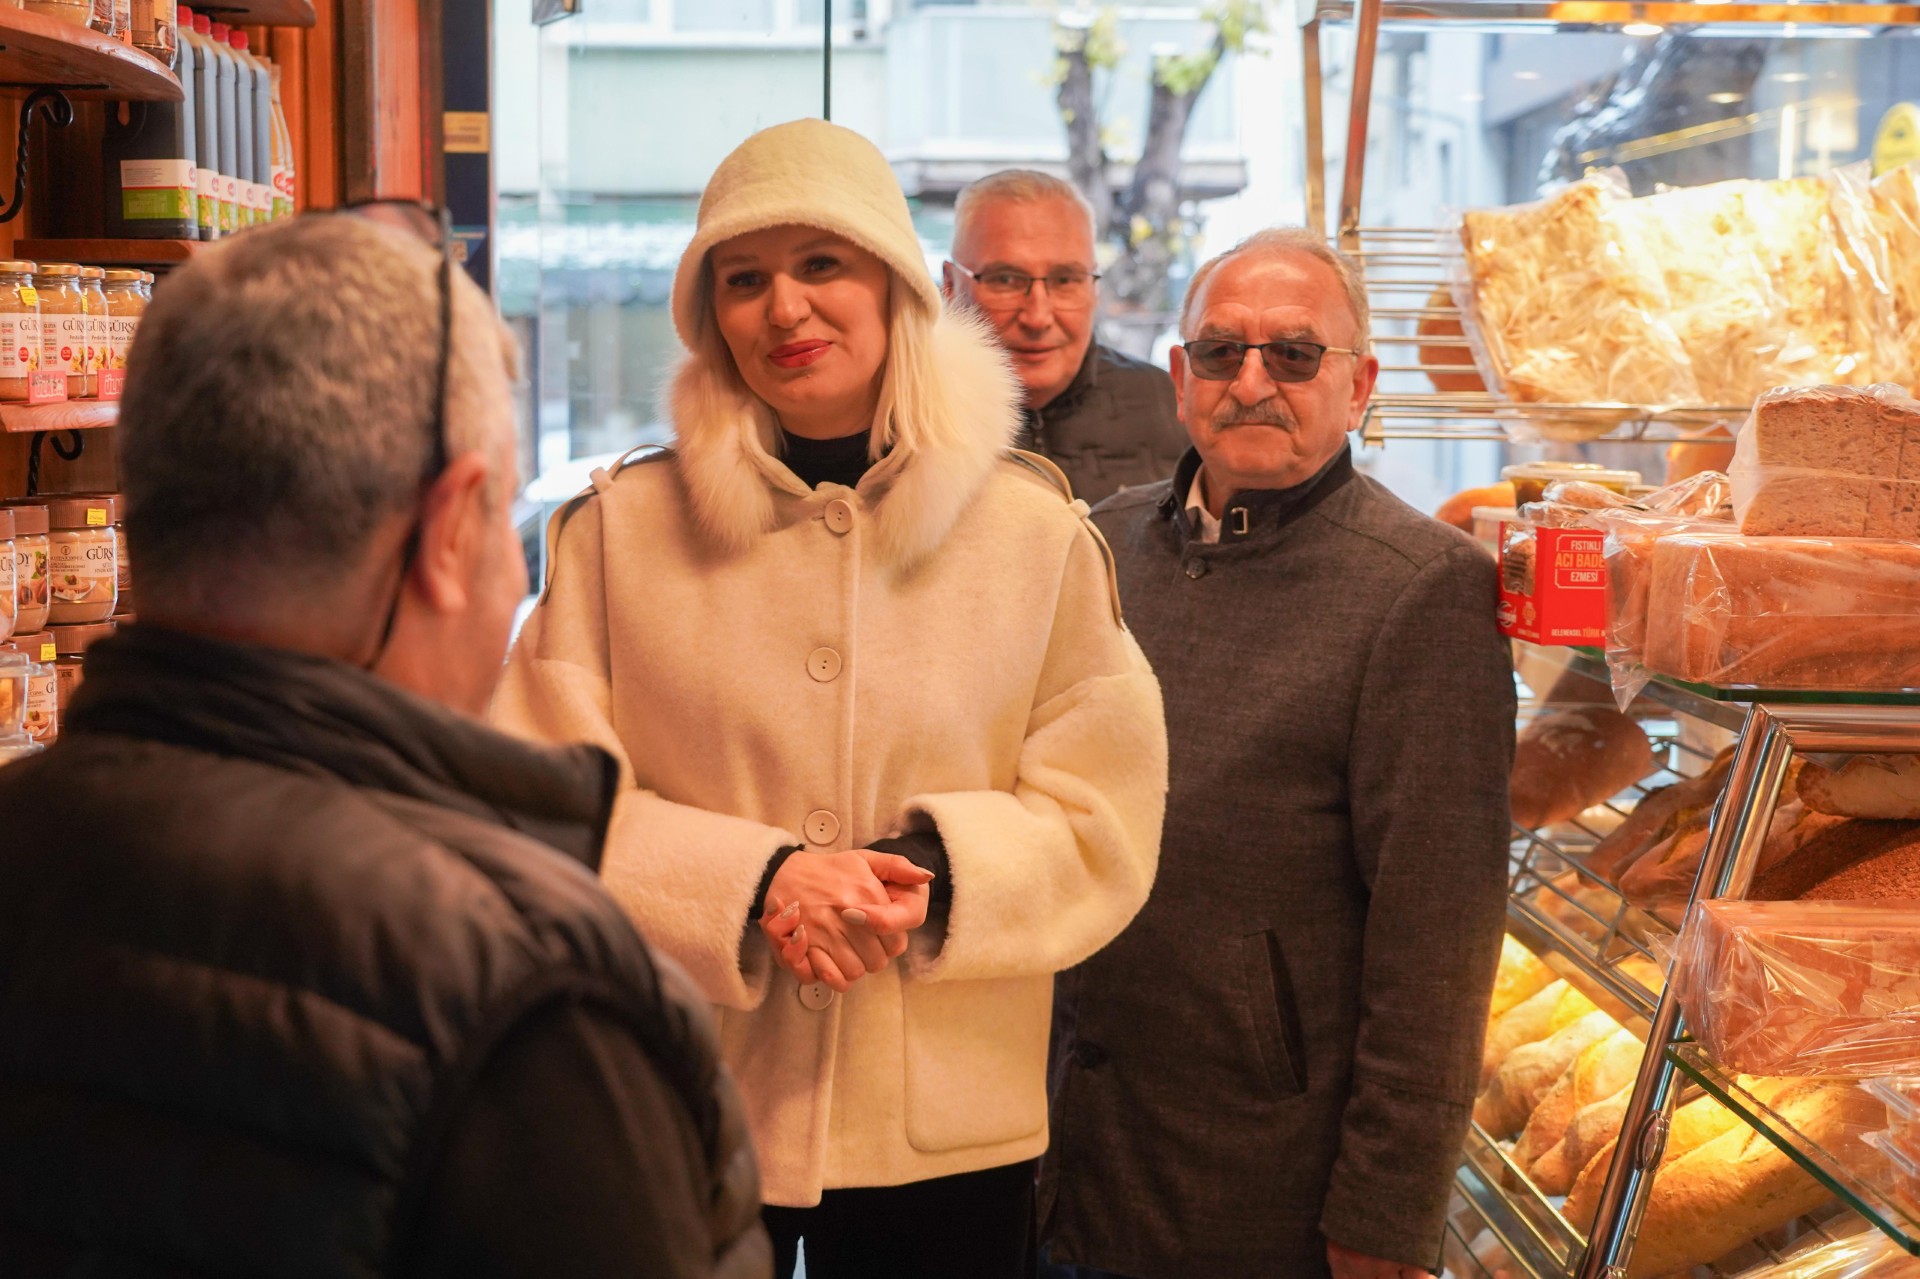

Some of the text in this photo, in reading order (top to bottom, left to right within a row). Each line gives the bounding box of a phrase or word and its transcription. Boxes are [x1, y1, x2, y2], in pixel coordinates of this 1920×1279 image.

[1571, 540, 1602, 550] FISTIKLI
[1555, 552, 1574, 568] ACI
[1571, 570, 1599, 582] EZMESİ
